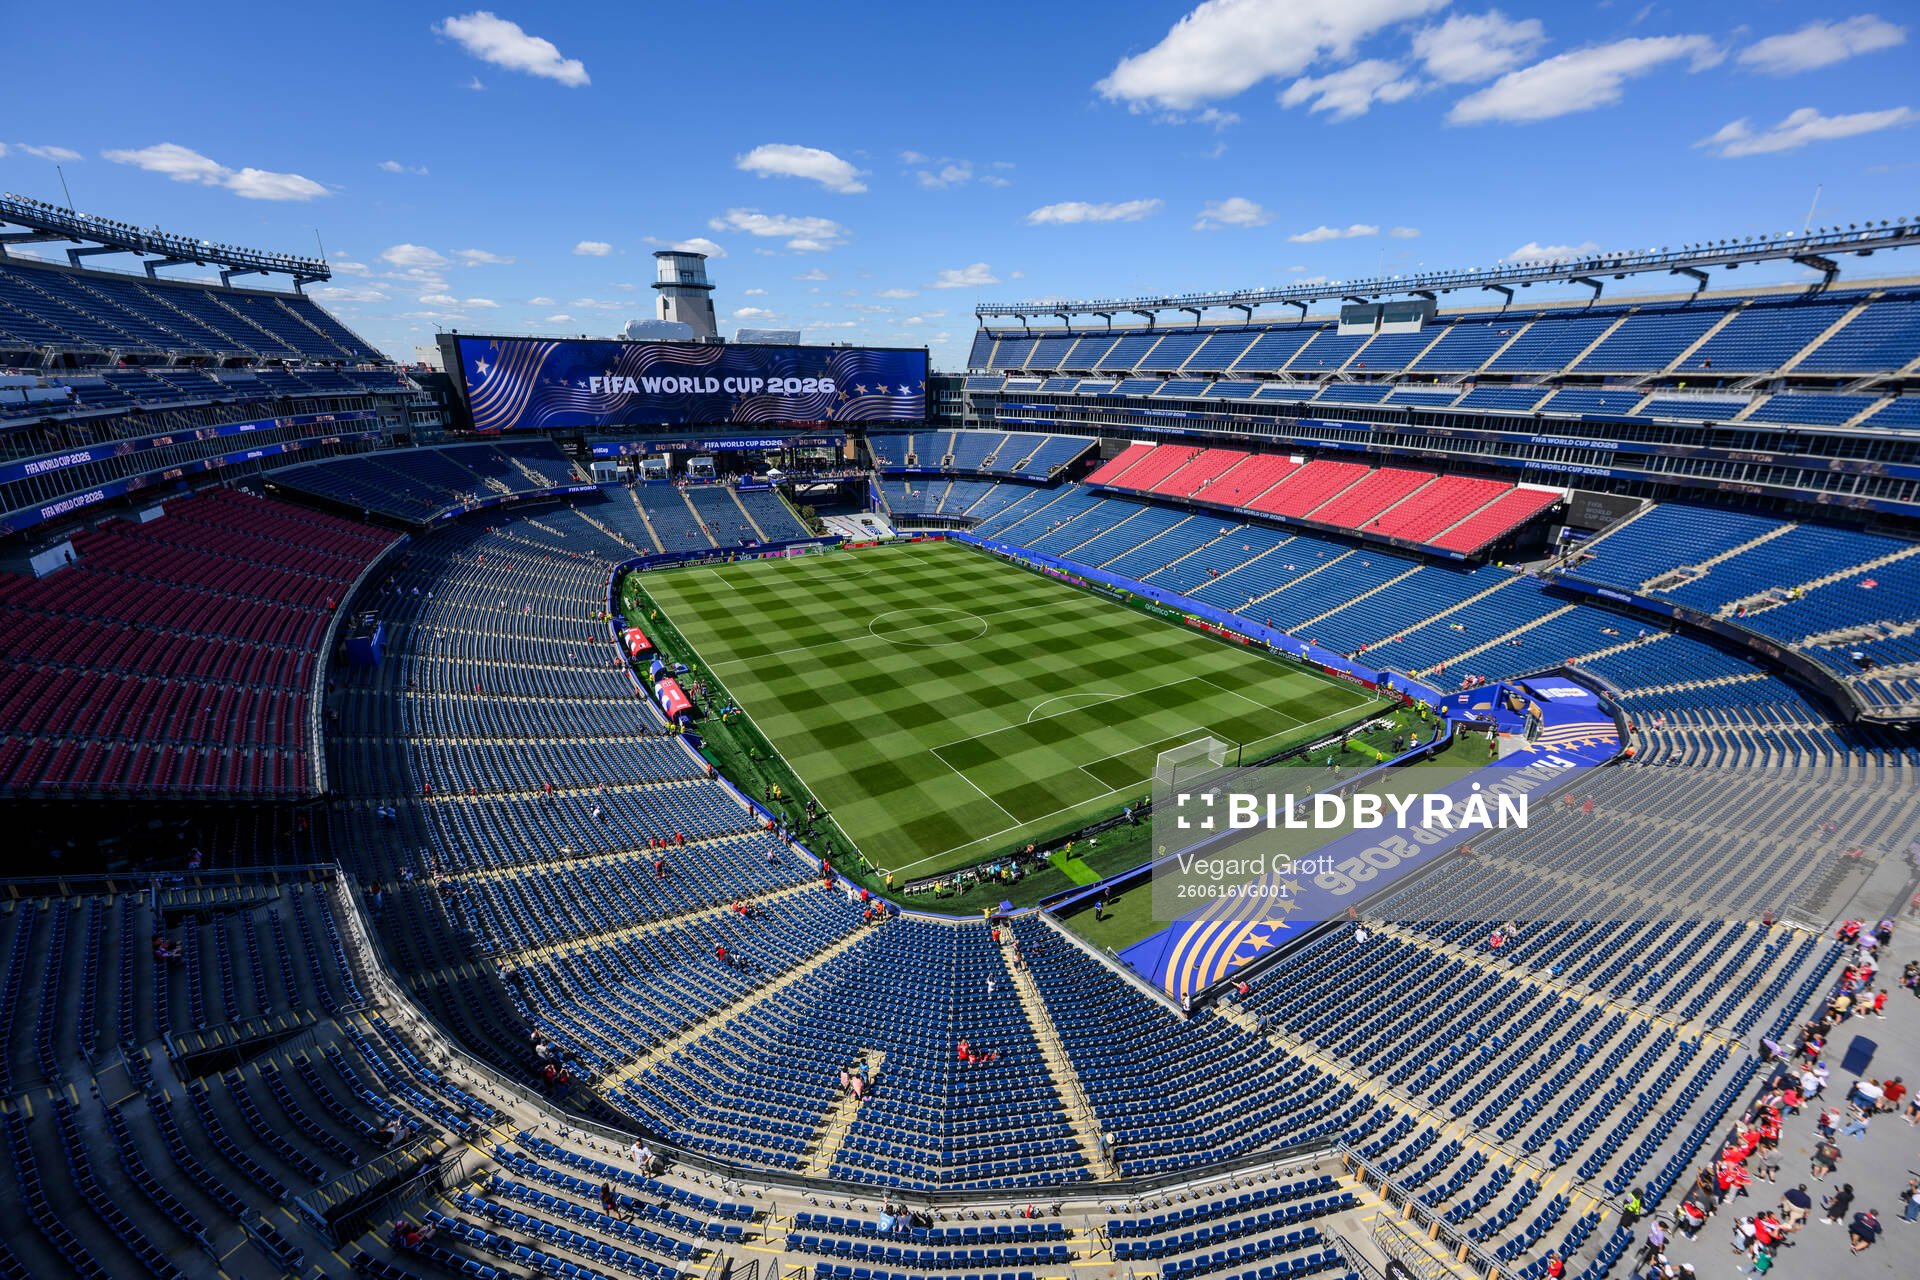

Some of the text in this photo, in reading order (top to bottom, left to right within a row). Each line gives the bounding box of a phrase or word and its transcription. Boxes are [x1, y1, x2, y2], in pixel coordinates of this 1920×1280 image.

[589, 376, 836, 394] FIFA WORLD CUP 2026
[704, 441, 719, 449] FIFA
[720, 440, 746, 448] WORLD
[760, 439, 783, 447] 2026
[1548, 438, 1574, 446] WORLD
[1590, 441, 1618, 449] 2026
[24, 451, 92, 475] FIFA WORLD CUP 2026
[1525, 461, 1611, 476] FIFA WORLD CUP 2026
[41, 490, 105, 519] FIFA WORLD CUP 2026
[1233, 506, 1286, 522] FIFA WORLD CUP 2026
[1145, 603, 1168, 617] aramco
[1336, 671, 1363, 685] Lenovo
[1516, 755, 1577, 782] FIFA
[1314, 835, 1421, 896] 2026
